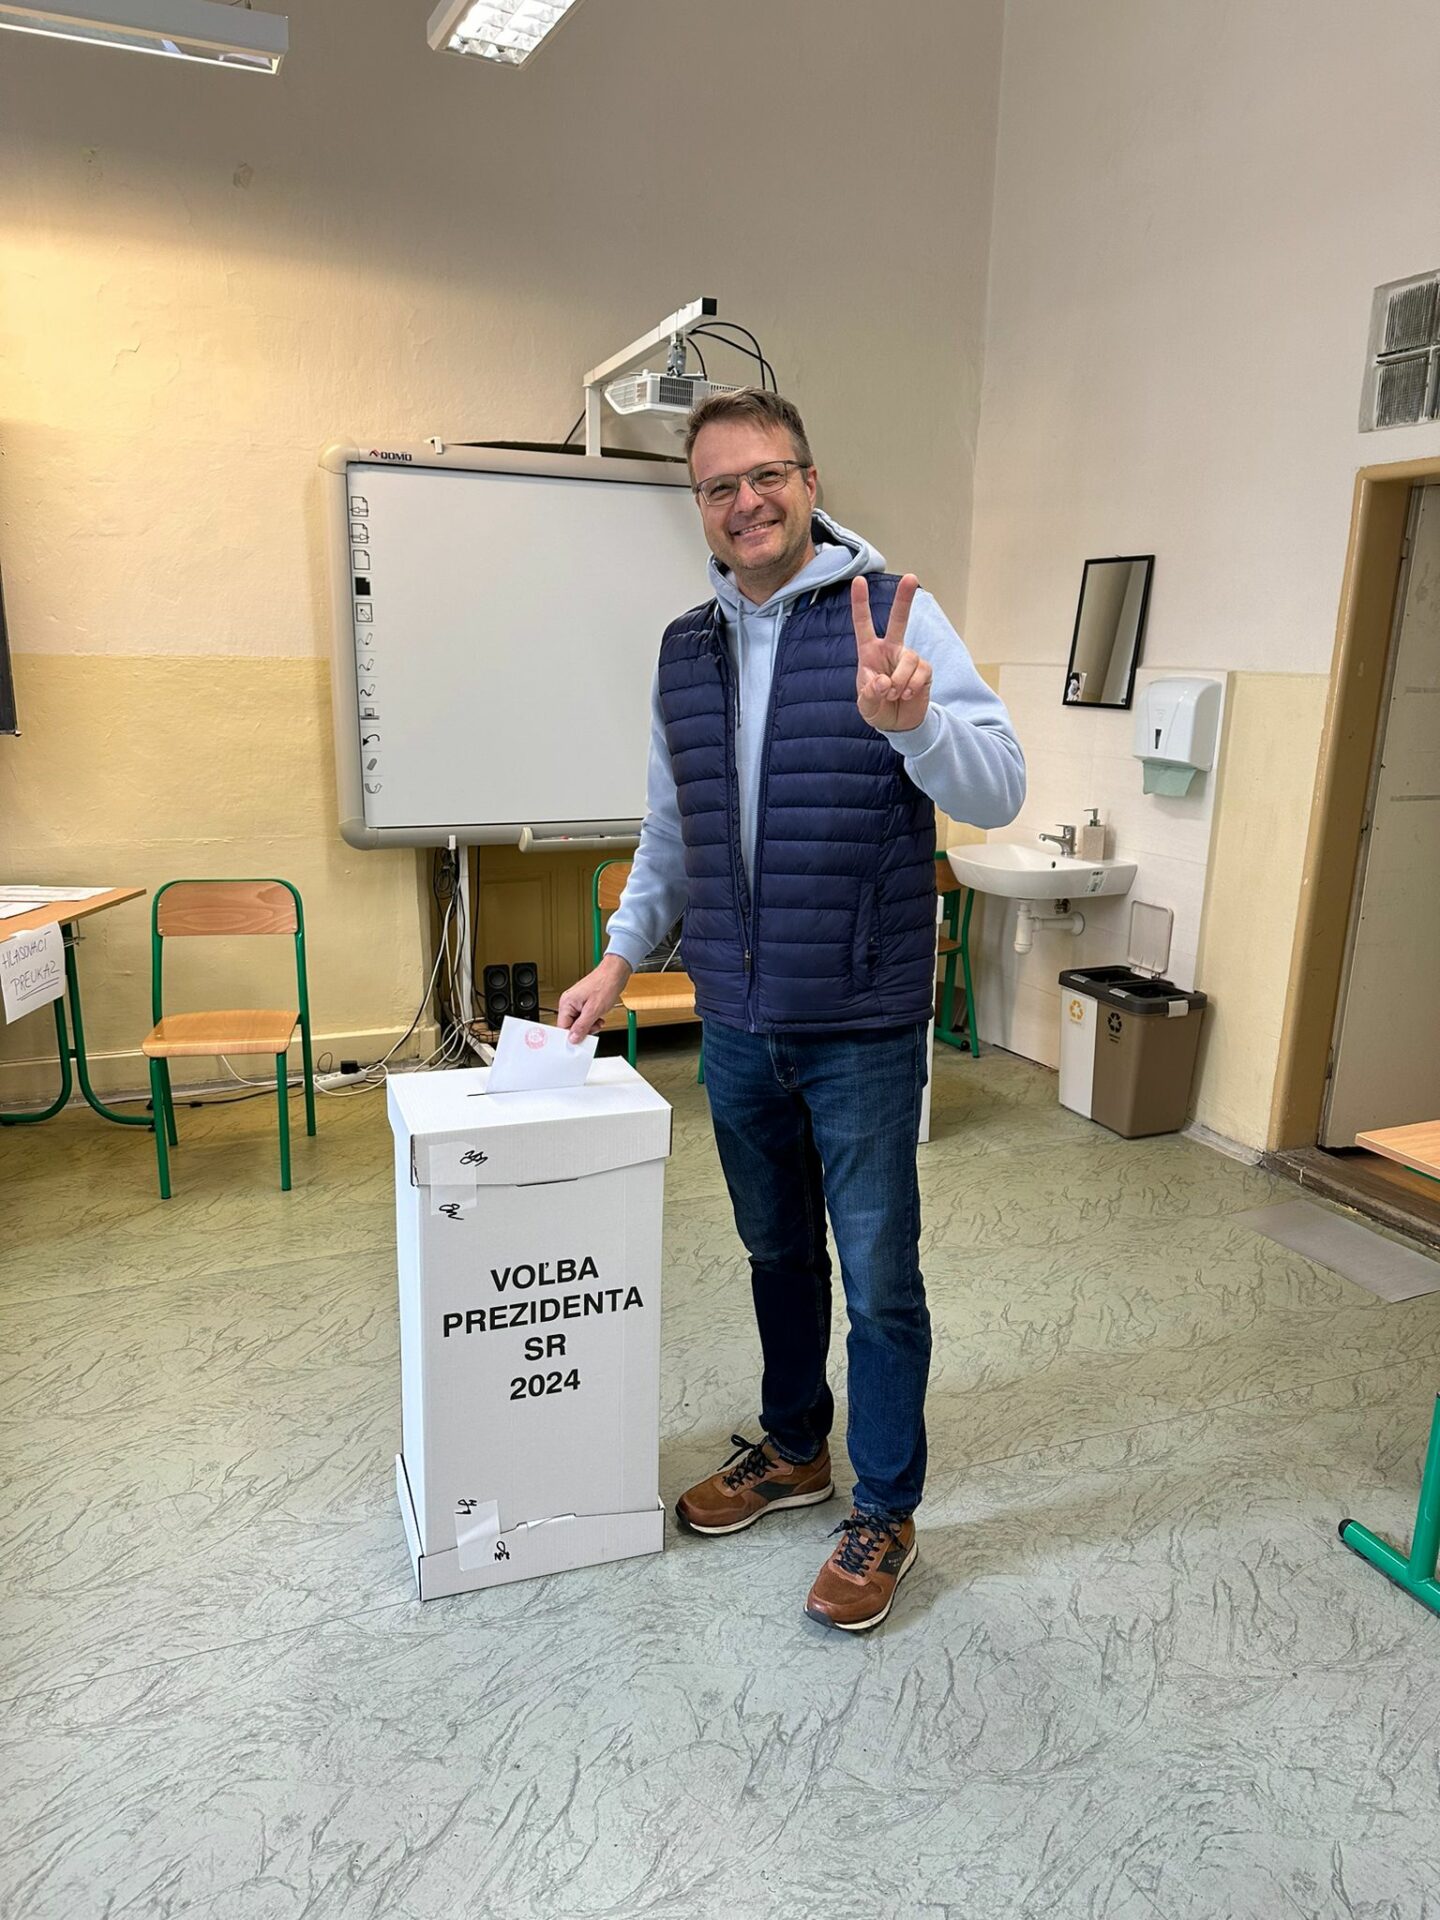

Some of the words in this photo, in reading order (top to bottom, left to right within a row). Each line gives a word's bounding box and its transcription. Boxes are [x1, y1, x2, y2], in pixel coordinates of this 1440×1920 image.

[490, 1256, 599, 1292] VOĽBA
[443, 1286, 644, 1338] PREZIDENTA
[524, 1333, 567, 1361] SR
[509, 1368, 581, 1400] 2024
